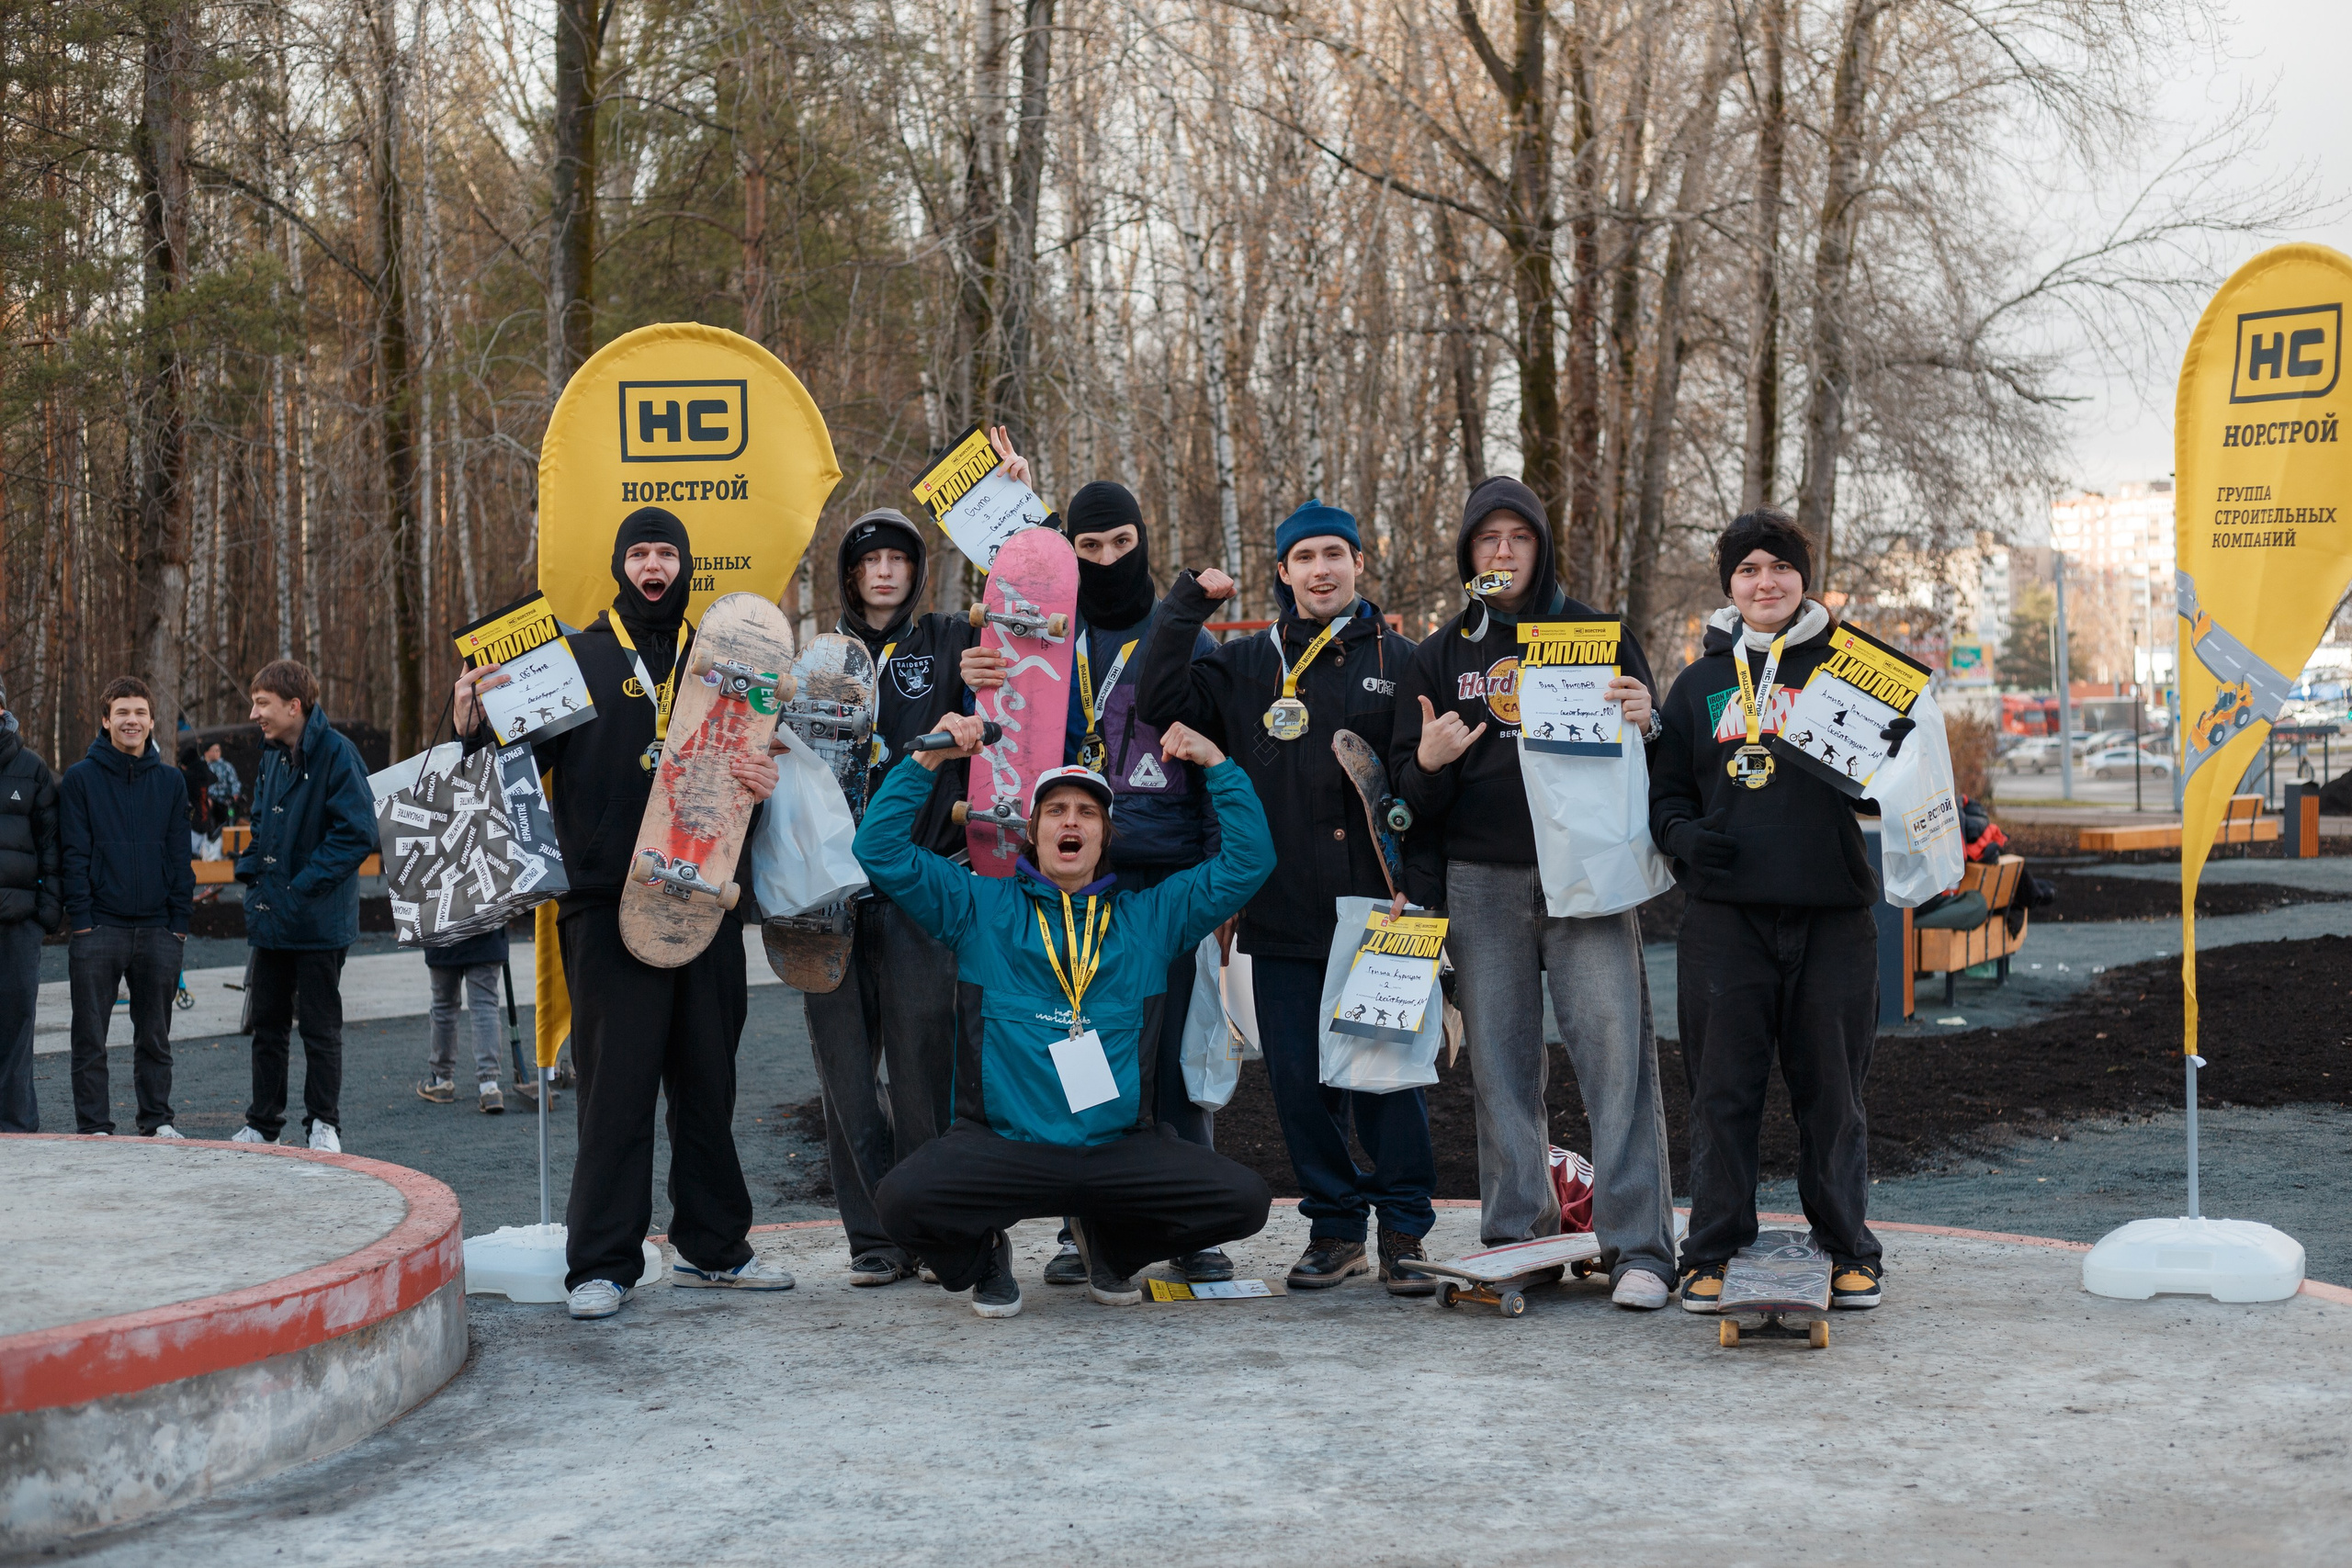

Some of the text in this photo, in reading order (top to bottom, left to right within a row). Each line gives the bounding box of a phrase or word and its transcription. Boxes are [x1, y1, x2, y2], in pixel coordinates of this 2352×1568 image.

[2249, 328, 2324, 381] НС
[639, 400, 729, 443] НС
[929, 444, 999, 523] ДИПЛОМ
[2217, 486, 2271, 502] ГРУППА
[2214, 508, 2337, 525] СТРОИТЕЛЬНЫХ
[2211, 528, 2296, 548] КОМПАНИЙ
[1301, 636, 1327, 664] НОРСТРОЙ
[1521, 640, 1618, 669] ДИПЛОМ
[897, 660, 929, 668] RAIDERS
[1080, 663, 1089, 694] НОРСТРОЙ
[1378, 679, 1396, 689] PICT
[1458, 671, 1514, 700] Hard
[1740, 671, 1751, 702] НОРСТРОЙ
[1817, 649, 1919, 712] ДИПЛОМ
[1377, 686, 1394, 696] URE
[1709, 694, 1724, 705] IRON
[1274, 709, 1286, 726] 2
[1833, 710, 1849, 727] 1
[1083, 746, 1091, 763] 3
[1737, 756, 1752, 774] 1
[1361, 930, 1443, 958] ДИПЛОМ
